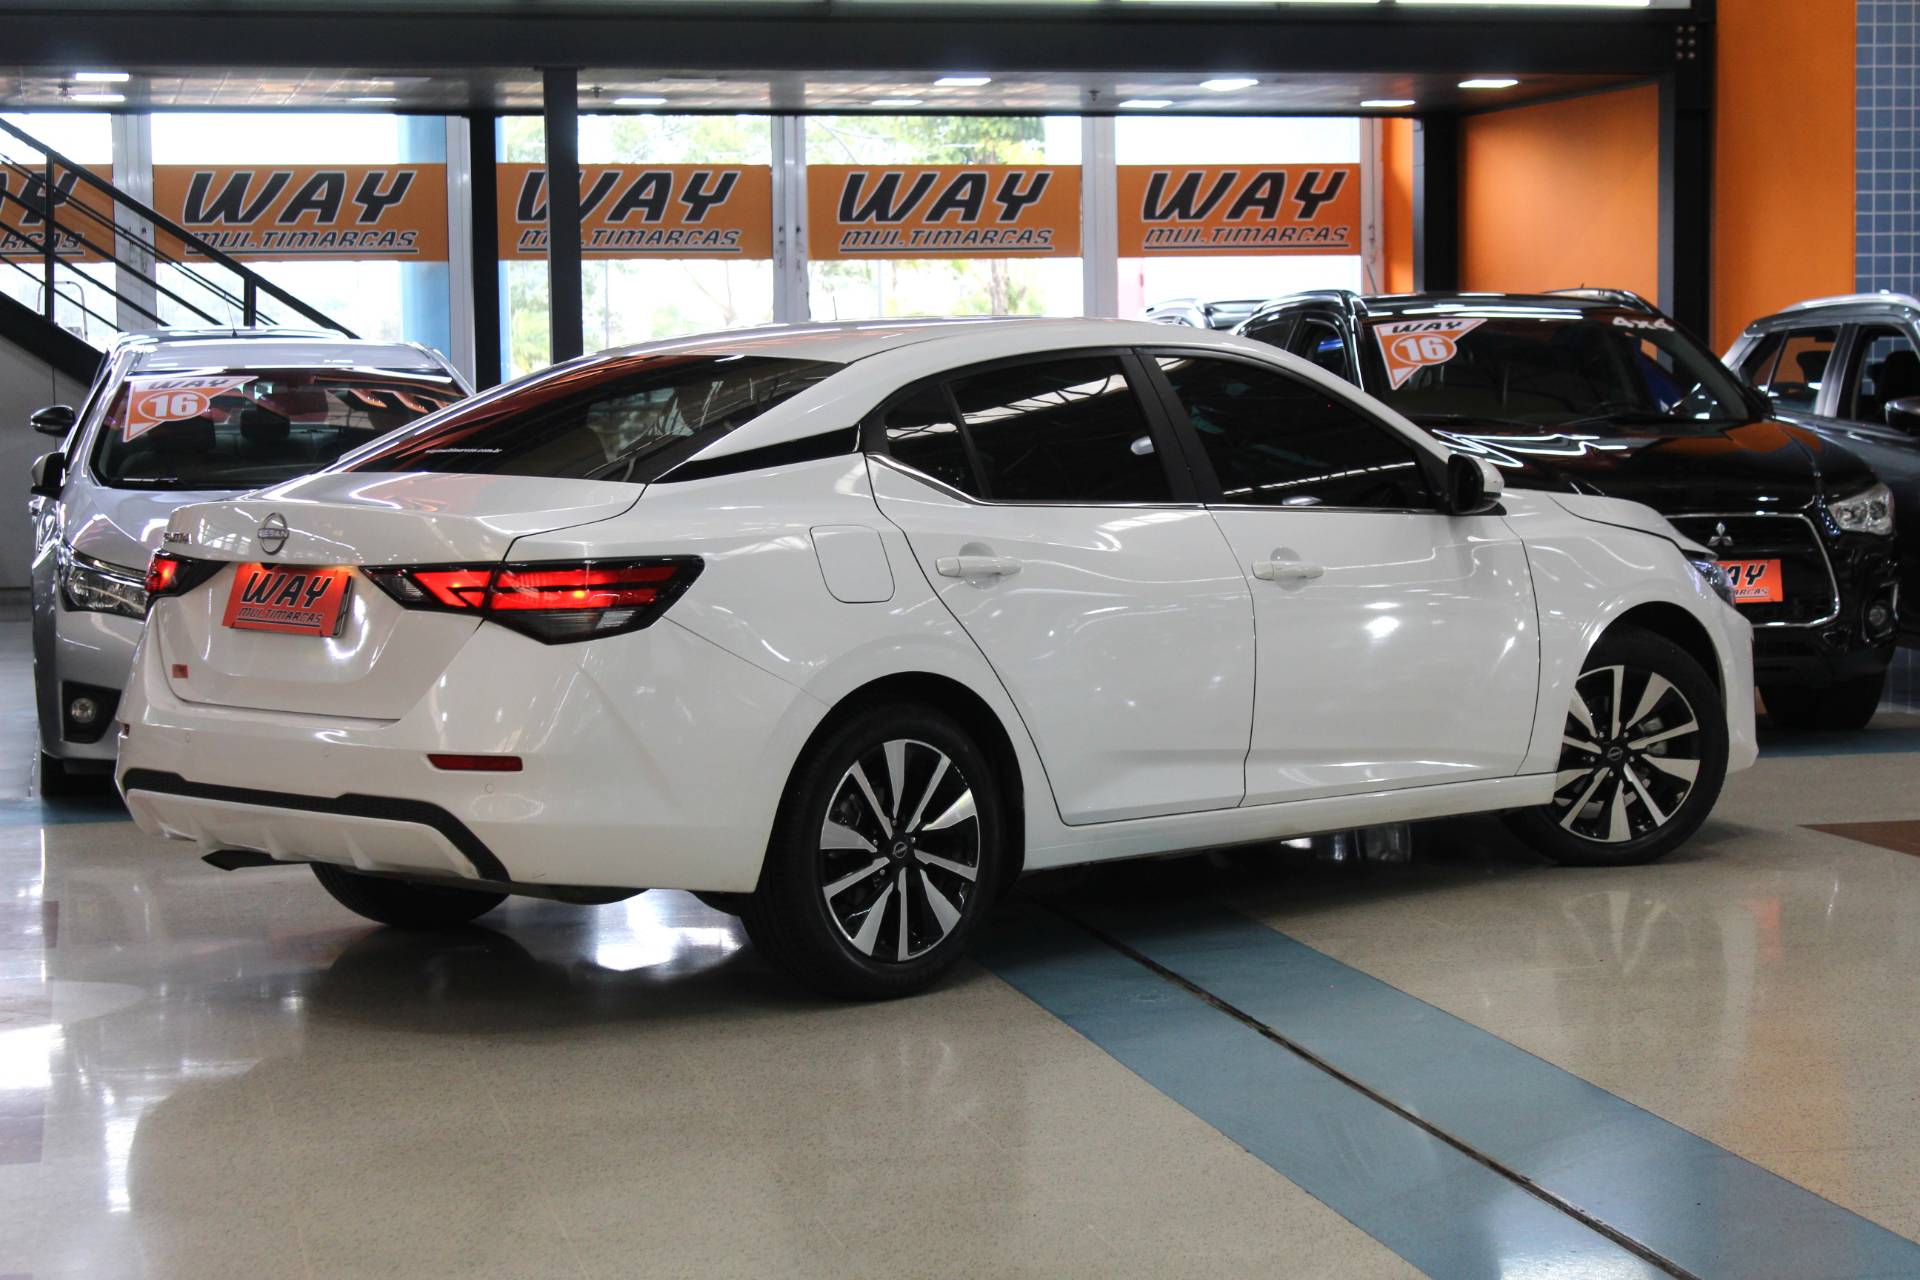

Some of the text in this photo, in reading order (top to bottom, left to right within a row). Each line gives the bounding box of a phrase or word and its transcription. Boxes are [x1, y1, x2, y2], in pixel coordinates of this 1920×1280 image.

[183, 170, 418, 226] WAY
[515, 170, 742, 223] WAY
[836, 170, 1054, 224] WAY
[1141, 170, 1350, 222] WAY
[518, 228, 742, 247] MTIMARCAS
[839, 227, 1053, 246] MULTIMARCAS
[1143, 226, 1350, 244] MULTIMARCAS
[1392, 321, 1463, 333] WAY
[1399, 335, 1448, 361] 16
[147, 379, 230, 390] WAY
[149, 393, 199, 417] 16
[1727, 563, 1767, 587] AY
[240, 570, 335, 609] WAY
[237, 607, 324, 623] MULTIMARCAS
